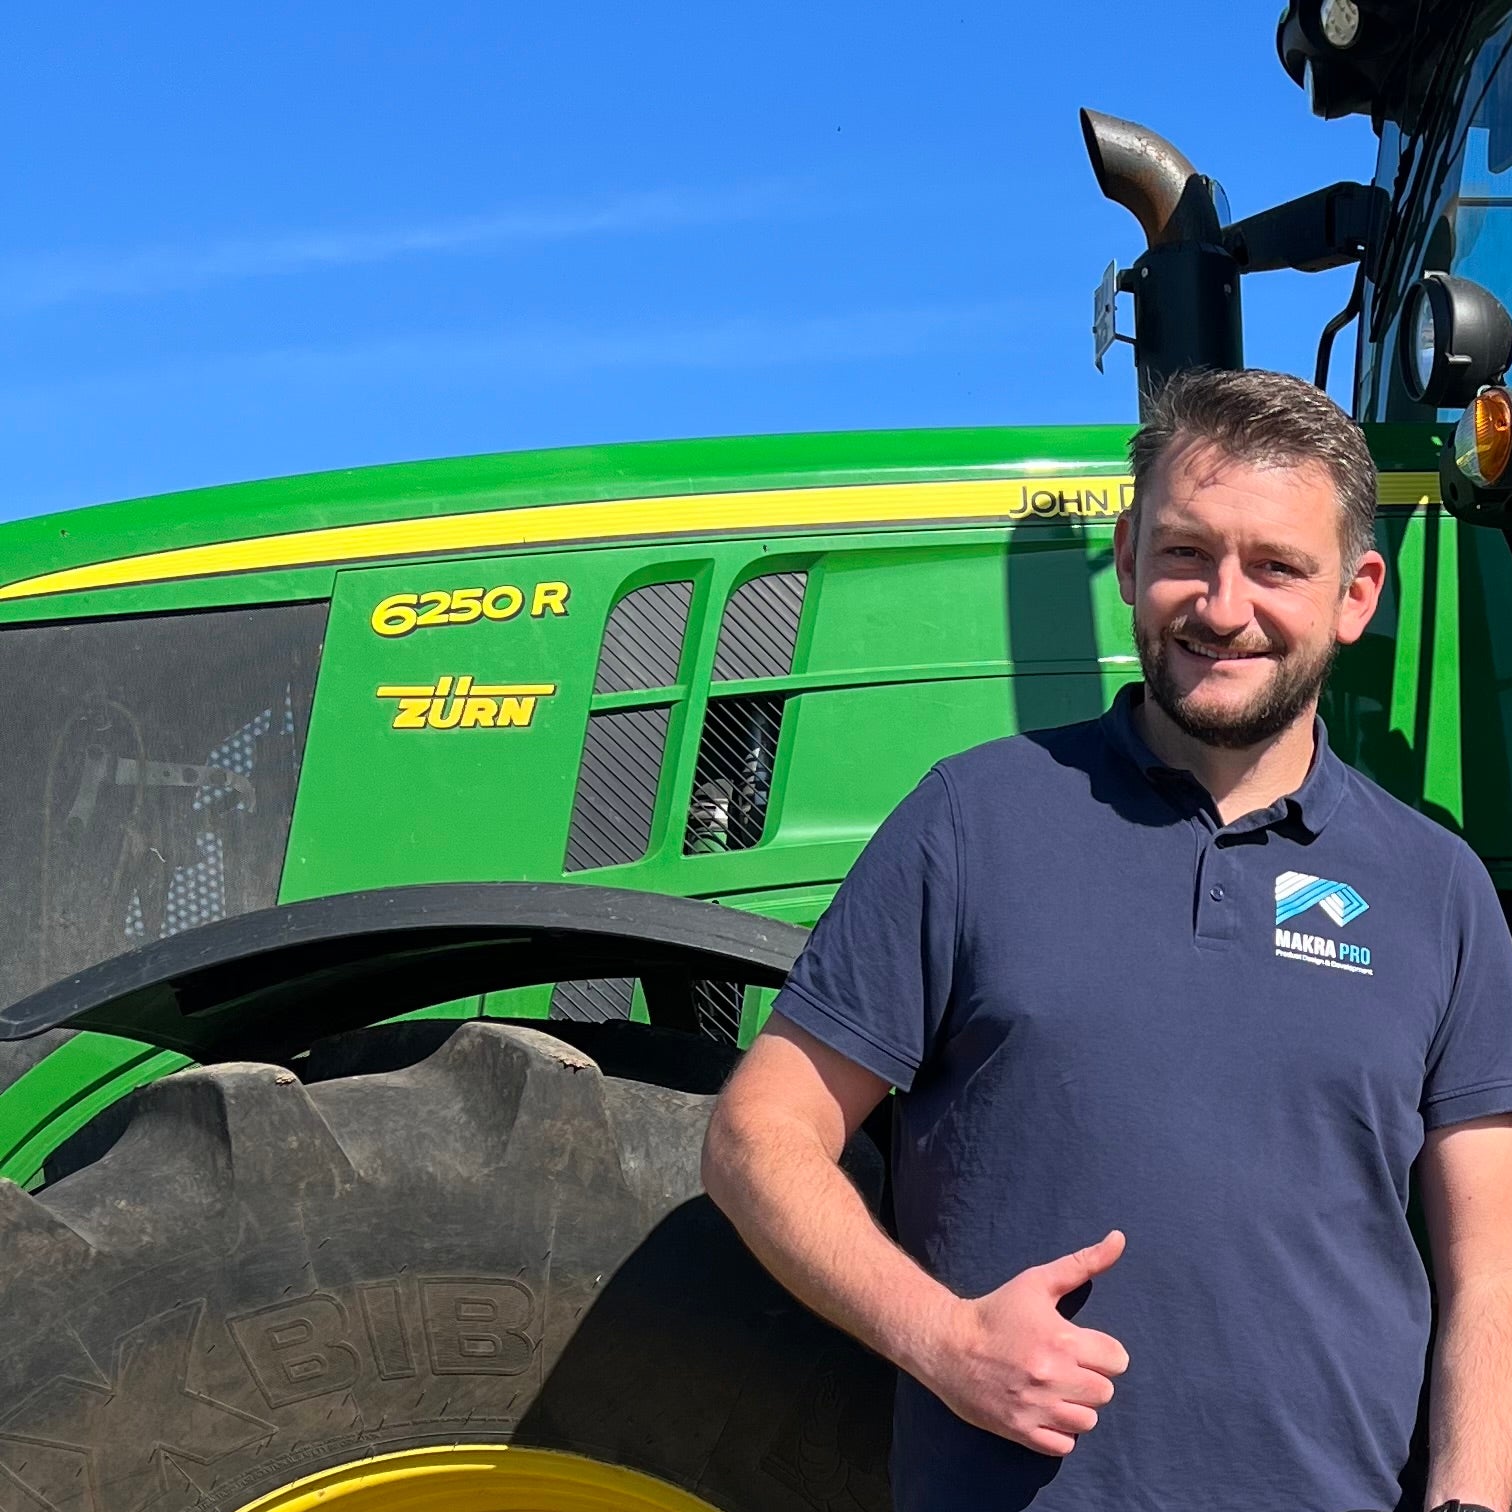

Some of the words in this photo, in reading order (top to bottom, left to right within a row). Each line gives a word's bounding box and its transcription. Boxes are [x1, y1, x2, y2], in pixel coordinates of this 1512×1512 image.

[1009, 486, 1108, 514] JOHN
[371, 586, 523, 637] 6250
[531, 581, 570, 616] R
[392, 675, 536, 729] ZÜRN
[1275, 928, 1336, 959] MAKRA
[1339, 942, 1371, 966] PRO
